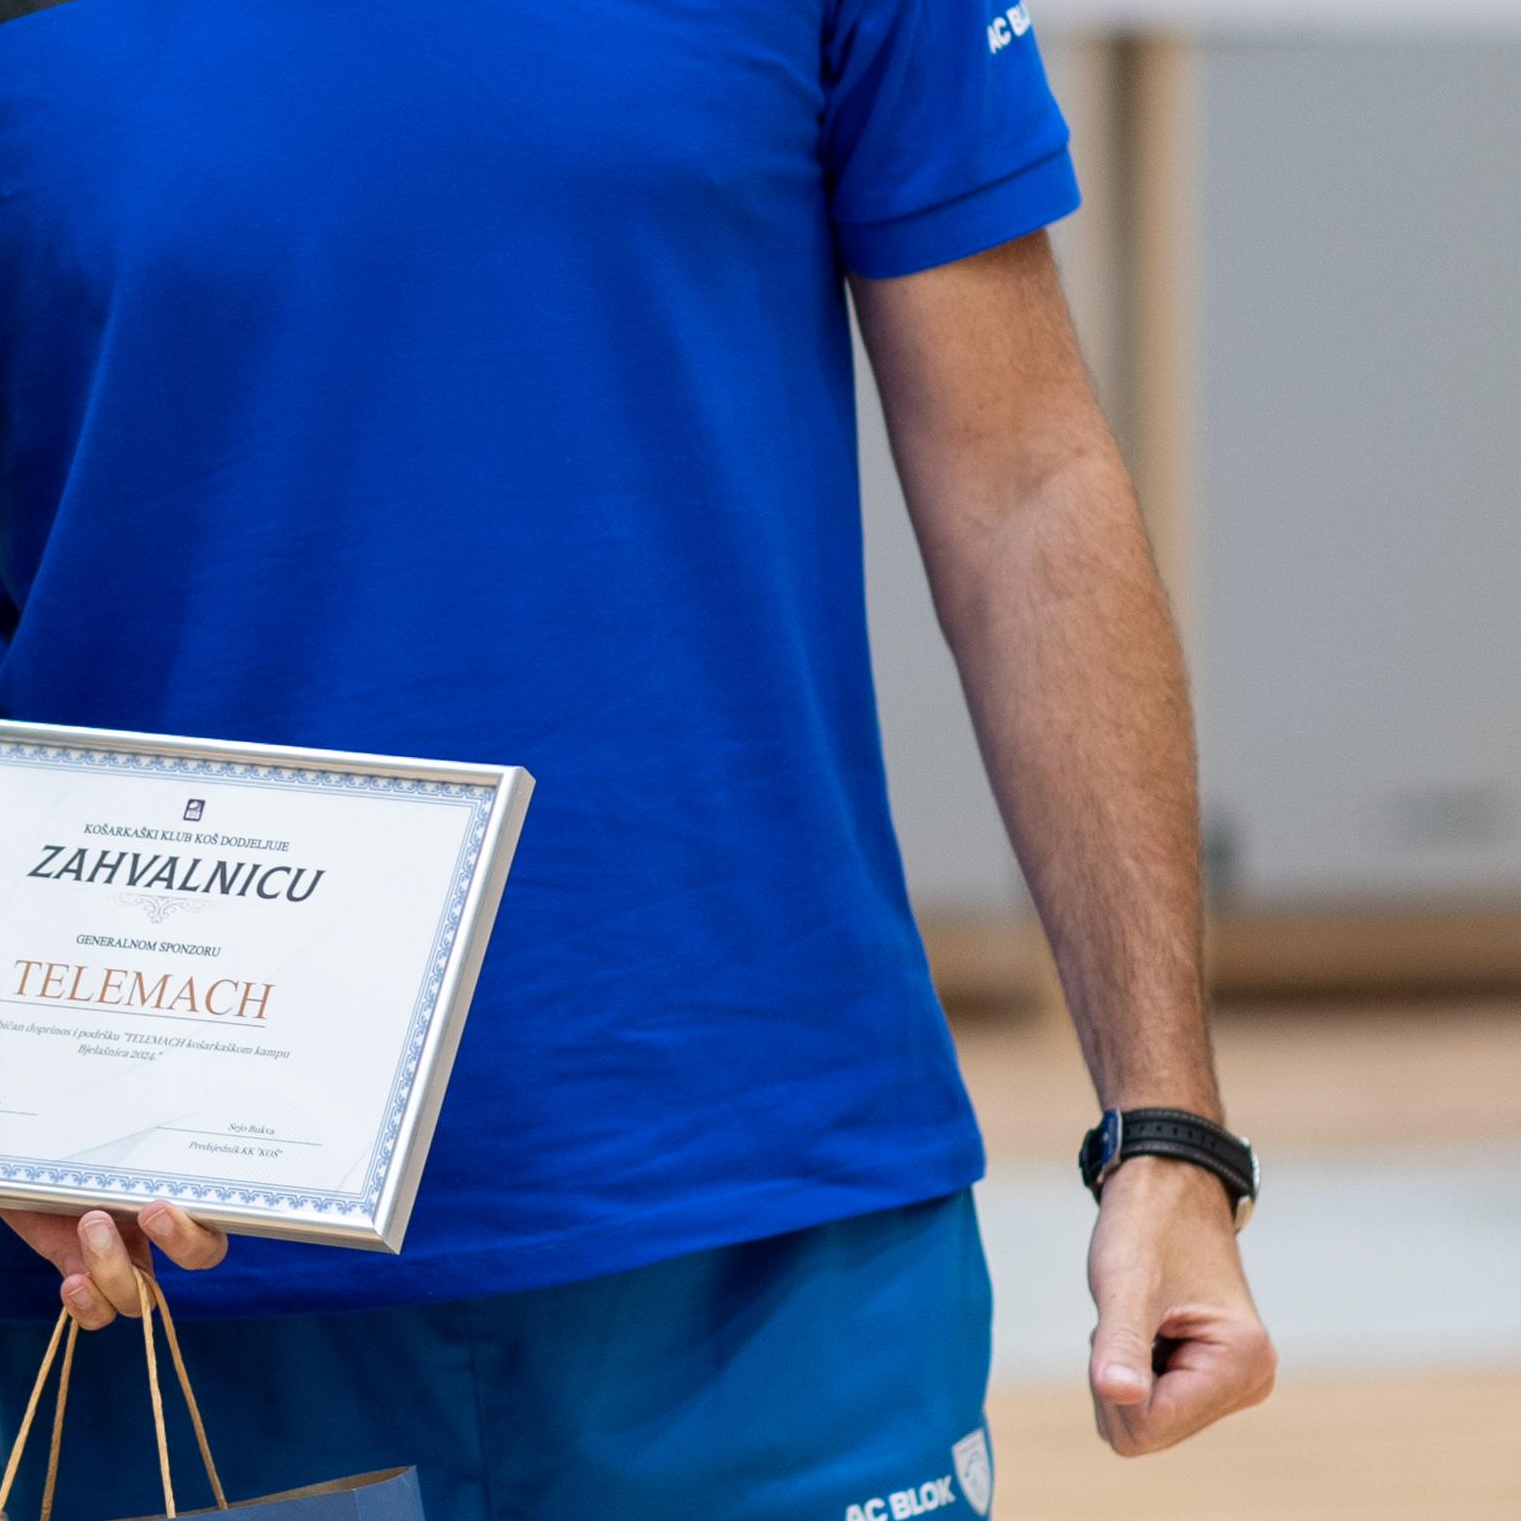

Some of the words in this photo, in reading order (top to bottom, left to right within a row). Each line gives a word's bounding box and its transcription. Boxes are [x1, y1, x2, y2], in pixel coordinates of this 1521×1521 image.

[987, 16, 1012, 54] AC
[83, 823, 159, 841] KOŠARKAŠKI
[160, 830, 192, 843] KLUB
[194, 833, 219, 845] KOŠ
[220, 836, 290, 852] DODJELJUJE
[26, 844, 326, 903] ZAHVALNICU
[76, 934, 158, 952] GENERALNOM
[159, 942, 221, 958] SPONZORU
[13, 959, 276, 1020] TELEMACH
[25, 1023, 71, 1036] doprinos
[77, 1029, 121, 1042] podršku
[187, 1039, 252, 1056] košarkaškom
[254, 1046, 291, 1060] kampu
[78, 1044, 129, 1058] Bjelašnica
[888, 1475, 956, 1521] BLOK
